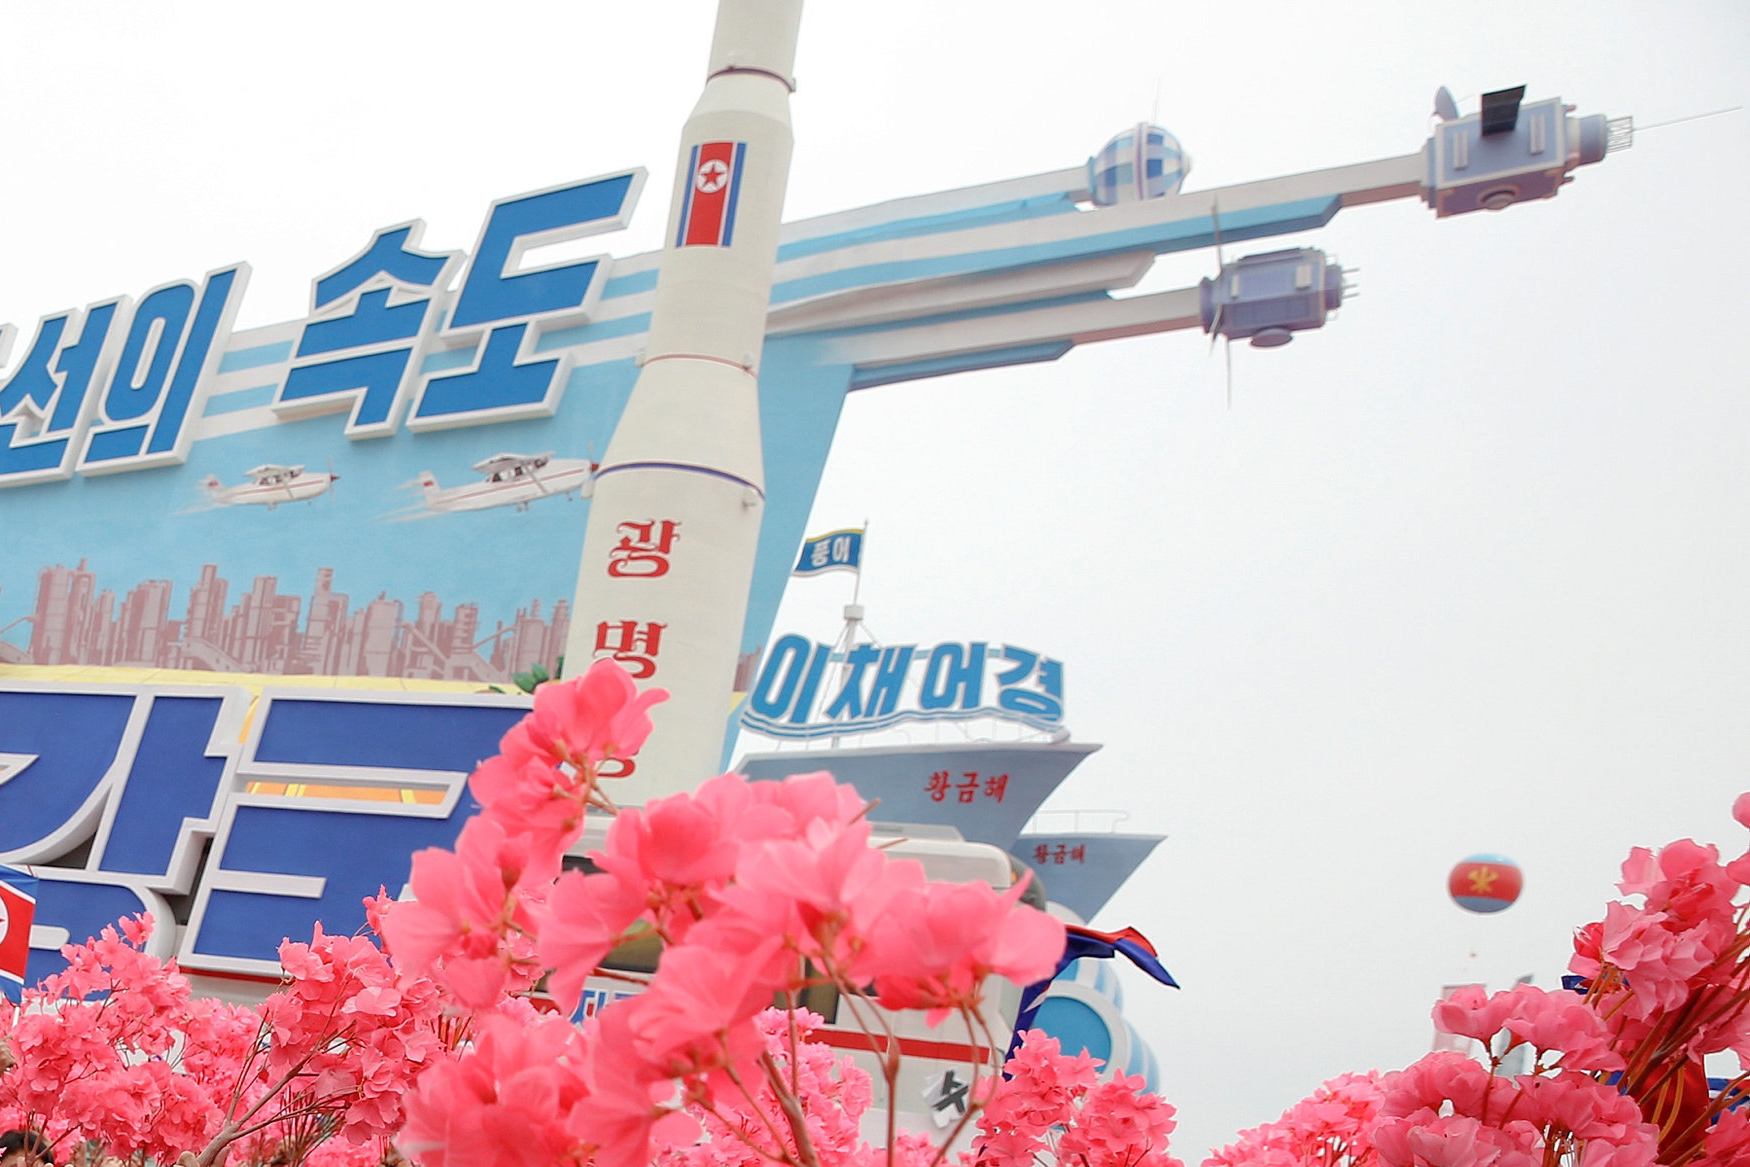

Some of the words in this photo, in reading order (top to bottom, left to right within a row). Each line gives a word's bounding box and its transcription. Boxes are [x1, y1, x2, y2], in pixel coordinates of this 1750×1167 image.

[271, 166, 648, 440] 속도
[750, 634, 1064, 724] 이채어경
[924, 770, 1010, 803] 황금해
